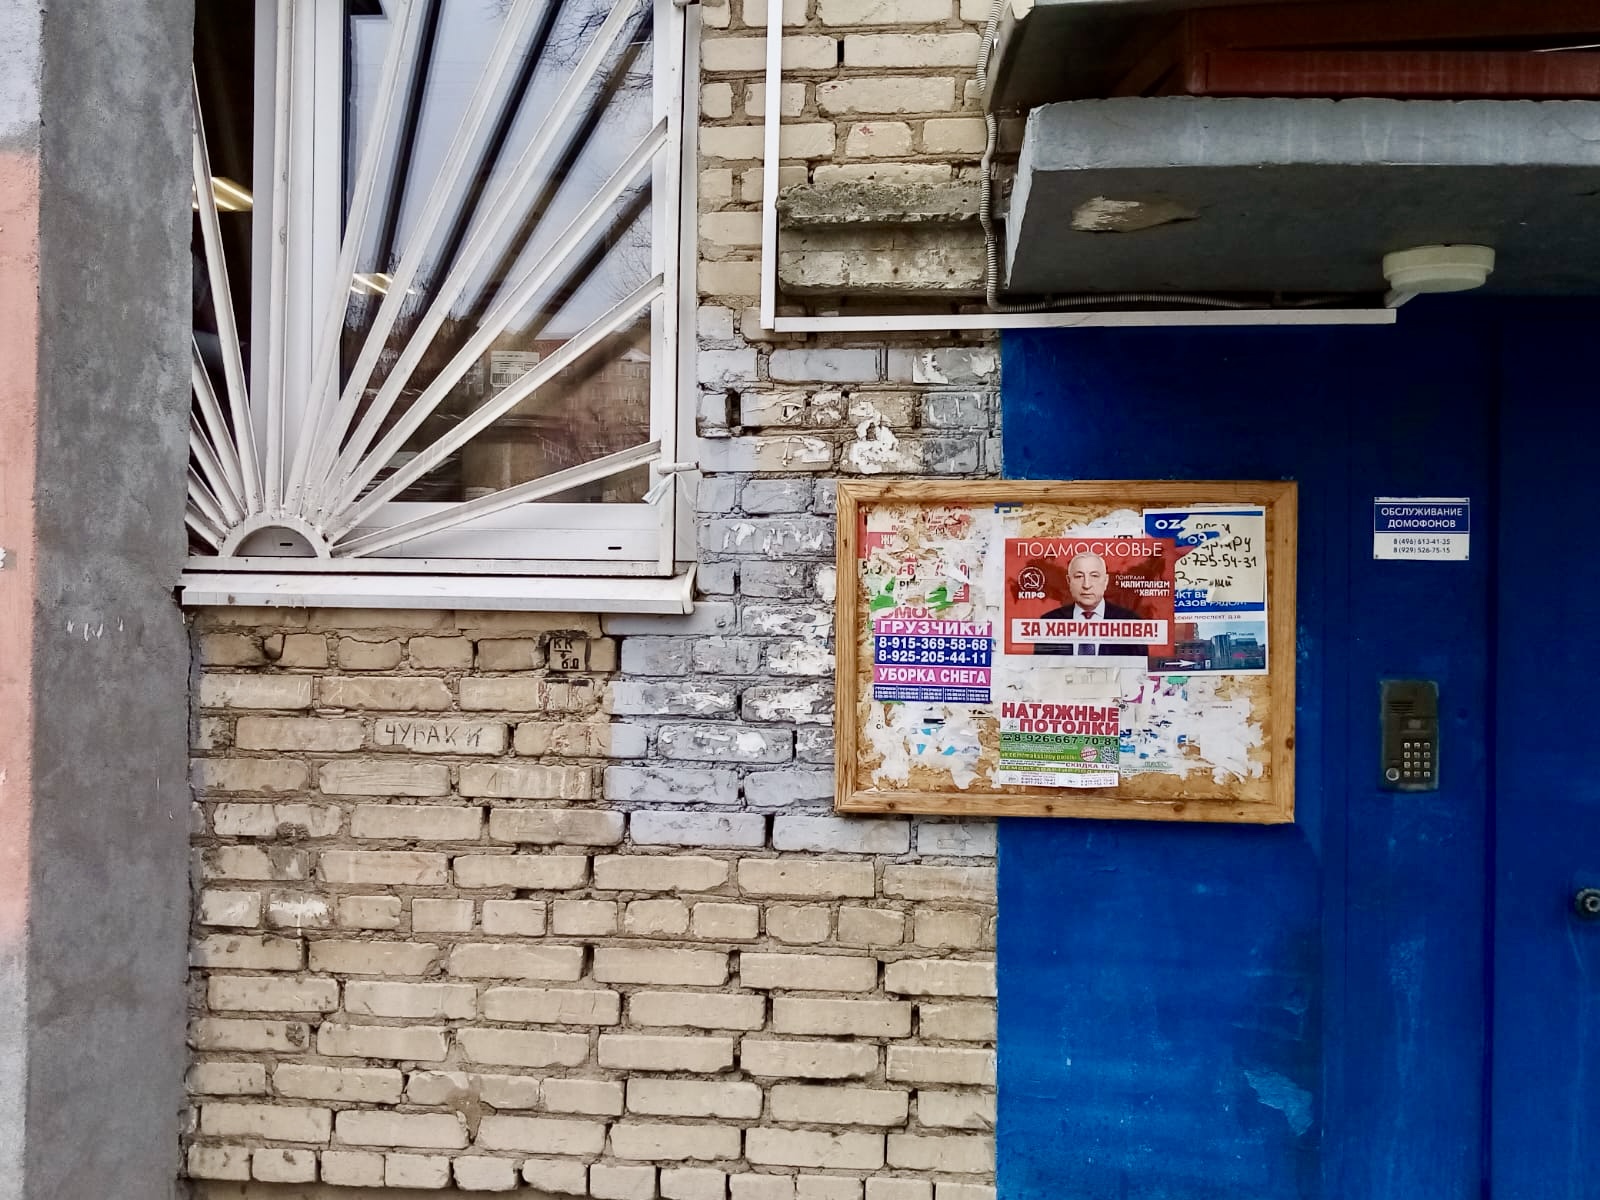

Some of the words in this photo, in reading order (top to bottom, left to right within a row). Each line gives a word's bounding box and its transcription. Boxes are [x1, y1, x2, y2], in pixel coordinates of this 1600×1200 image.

[1381, 507, 1463, 516] ОБСЛУЖИВАНИЕ
[1388, 519, 1456, 528] ДОМОФОНОВ
[1017, 541, 1163, 558] ПОДМОСКОВЬЕ
[1018, 591, 1046, 600] КПРФ
[1139, 589, 1170, 597] ХВАТИТ!
[881, 620, 990, 636] ГРУЗЧИКИ
[1021, 621, 1041, 637] ЗА
[1046, 621, 1159, 638] ХАРИТОНОВА!
[878, 636, 988, 651] 8-915-369-58-68
[878, 650, 986, 664] 8-925-205-44-11
[879, 667, 936, 683] УБОРКА
[940, 669, 987, 683] СНЕГА
[1002, 702, 1120, 723] НАТЯЖНЫЕ
[1019, 719, 1120, 736] ПОТОЛКИ
[1014, 734, 1119, 746] 8-926-667-70-81
